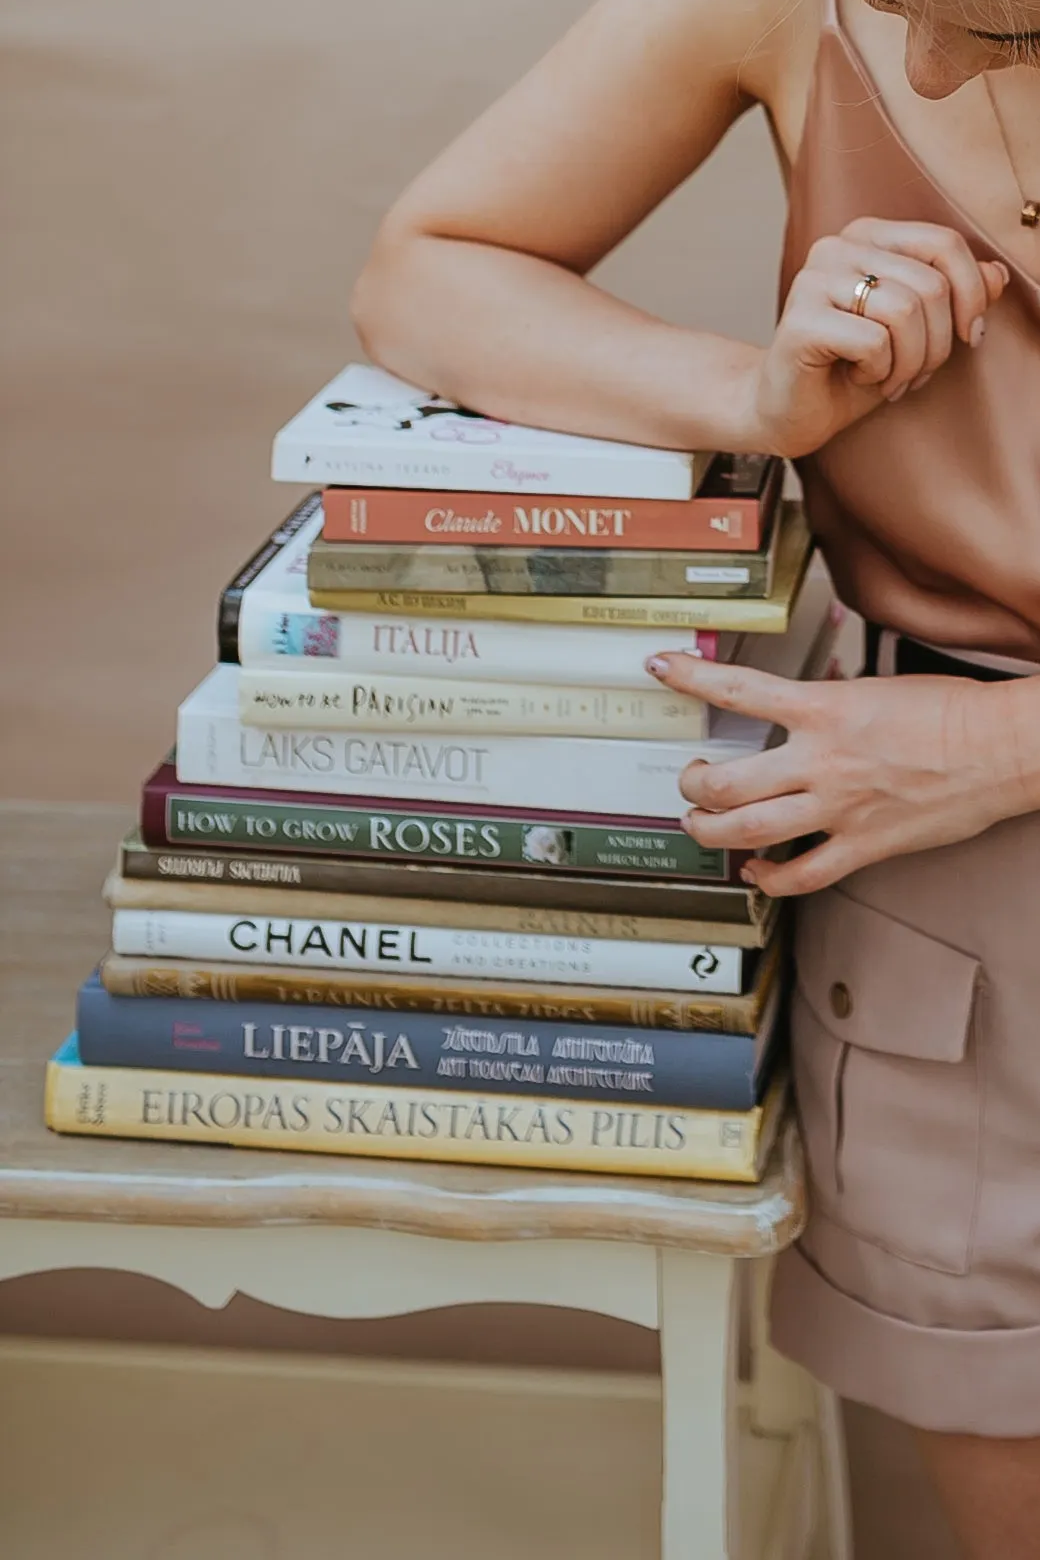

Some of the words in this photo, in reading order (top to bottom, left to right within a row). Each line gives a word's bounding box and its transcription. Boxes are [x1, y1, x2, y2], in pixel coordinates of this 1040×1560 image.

[423, 507, 502, 534] Claude
[511, 506, 633, 536] MONET
[351, 683, 455, 722] PARISIAN
[239, 730, 336, 772] LAIKS
[343, 737, 492, 783] GATAVOT
[177, 809, 237, 834] HOW
[243, 815, 278, 838] TO
[281, 818, 361, 843] GROW
[368, 815, 502, 859] ROSES
[606, 834, 669, 851] ANDREW
[229, 919, 432, 964] CHANEL
[452, 933, 592, 955] COLLECTIONS
[451, 954, 488, 967] AND
[492, 956, 592, 973] CREATIONS
[240, 1021, 422, 1073] LIEPĀJA
[436, 1055, 468, 1078] ART
[469, 1058, 545, 1085] NOUVEAU
[546, 1064, 655, 1092] ARCHITECTURE
[140, 1087, 312, 1132] EIROPAS
[322, 1096, 575, 1146] SKAISTĀKĀS
[591, 1110, 688, 1151] PILIS
